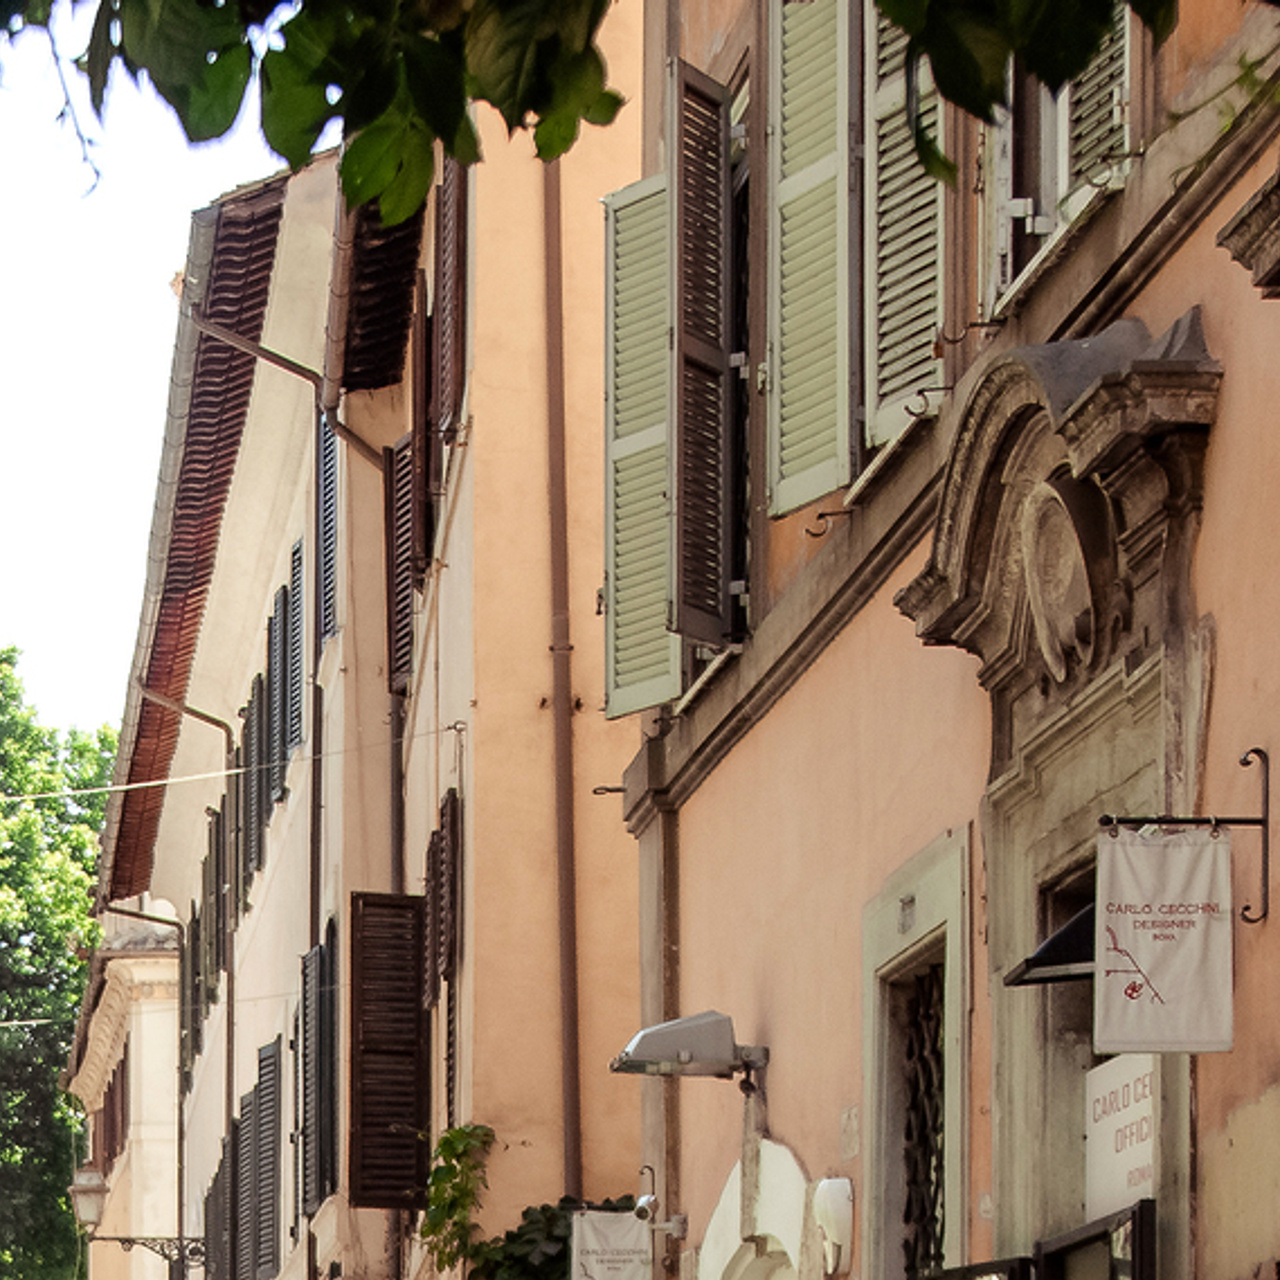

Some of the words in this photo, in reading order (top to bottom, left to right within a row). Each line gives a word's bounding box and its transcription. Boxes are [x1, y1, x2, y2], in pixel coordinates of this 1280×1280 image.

[1106, 902, 1152, 914] CARLO
[1158, 903, 1220, 914] CECCHINI
[1133, 920, 1195, 930] DESIGNER
[1092, 1082, 1130, 1123] CARLO
